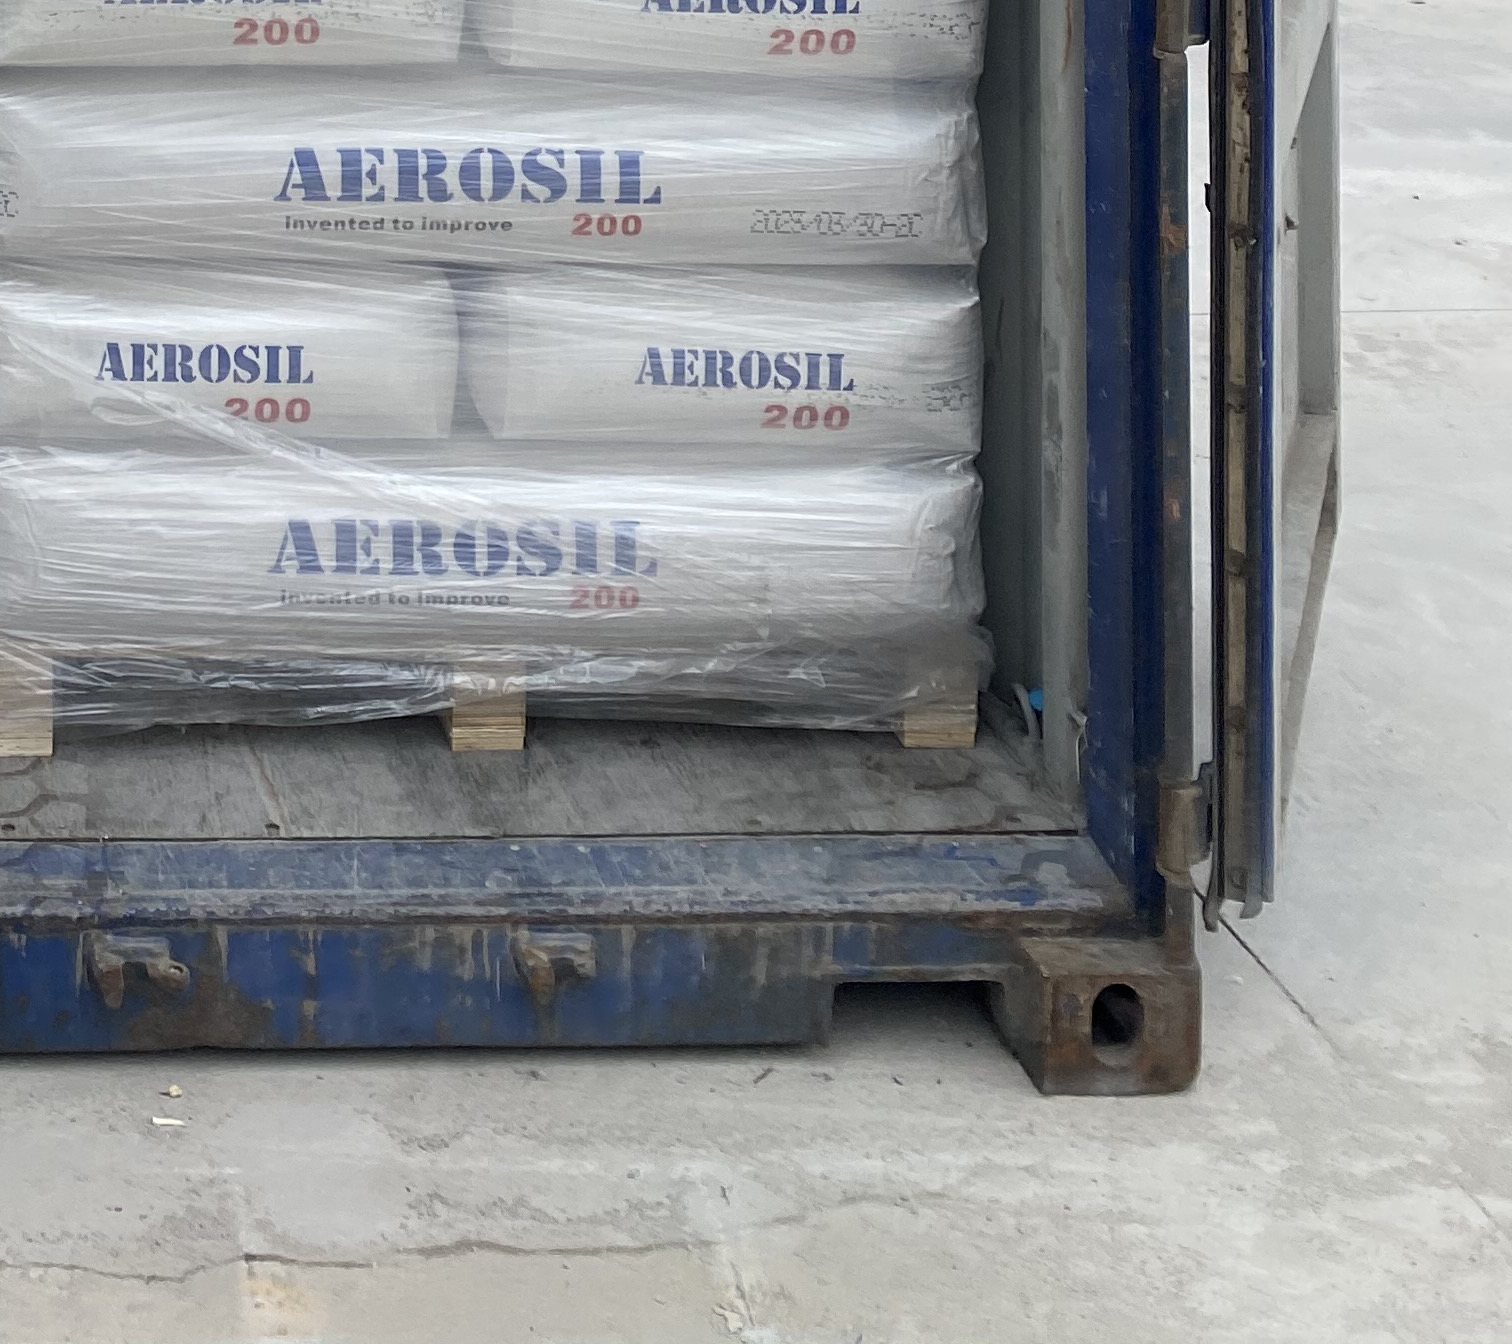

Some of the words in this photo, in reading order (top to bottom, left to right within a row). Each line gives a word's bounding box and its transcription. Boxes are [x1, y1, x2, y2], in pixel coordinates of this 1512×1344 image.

[234, 17, 321, 46] 200
[769, 28, 856, 56] 200
[273, 147, 662, 203] AEROSIL
[286, 216, 384, 230] invented
[392, 218, 414, 230] to
[422, 216, 513, 233] improve
[572, 212, 643, 237] 200
[94, 342, 313, 384] AEROSIL
[636, 347, 854, 390] AEROSIL
[225, 396, 311, 423] 200
[763, 403, 850, 430] 200
[269, 519, 658, 577] AEROSIL
[389, 590, 409, 605] to
[570, 583, 642, 610] 200
